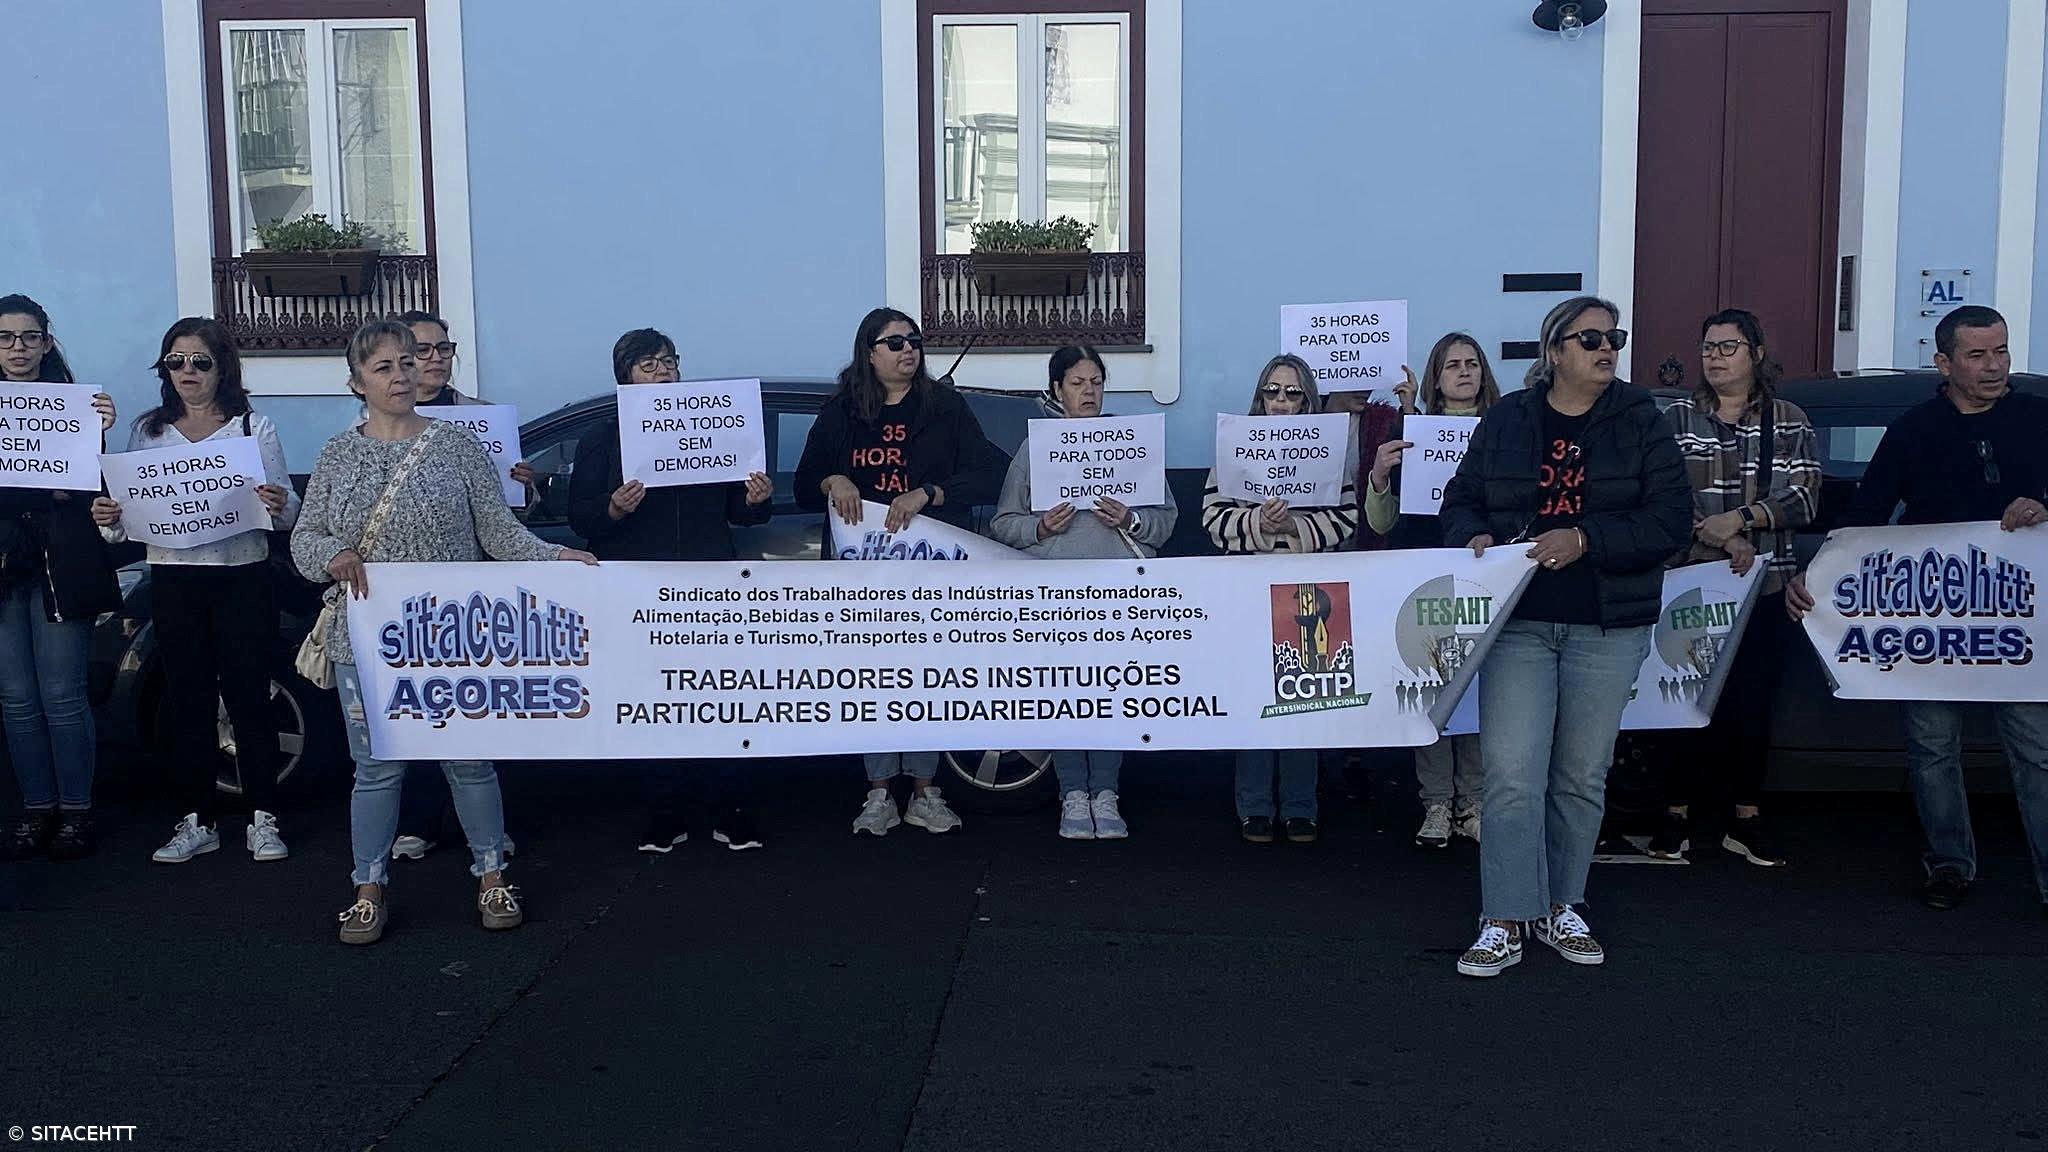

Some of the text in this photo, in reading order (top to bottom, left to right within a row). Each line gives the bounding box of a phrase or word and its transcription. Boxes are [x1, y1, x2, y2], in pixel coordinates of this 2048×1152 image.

[1927, 280, 1963, 301] AL
[1311, 314, 1378, 328] 35 HORAS
[1300, 332, 1389, 346] PARA TODOS
[1331, 350, 1359, 362] SEM
[1311, 366, 1383, 381] DEMORAS!
[0, 396, 65, 411] HORAS
[654, 395, 731, 411] 35 HORAS
[16, 418, 80, 432] TODOS
[642, 415, 744, 432] PARA TODOS
[882, 424, 907, 442] 35
[1061, 429, 1134, 444] 35 HORAS
[1249, 428, 1319, 441] 35 HORAS
[1438, 430, 1454, 442] 35
[2, 438, 40, 451] SEM
[679, 437, 712, 450] SEM
[852, 447, 907, 468] HOR
[1050, 447, 1146, 462] PARA TODOS
[1236, 447, 1328, 460] PARA TODOS
[0, 458, 69, 473] MORAS!
[138, 455, 226, 479] 35 HORAS
[655, 454, 736, 472] DEMORAS!
[874, 468, 909, 492] JÁ!
[1083, 467, 1114, 479] SEM
[1268, 466, 1296, 479] SEM
[1539, 464, 1585, 487] ORA
[128, 475, 244, 499] PARA TODOS
[1059, 481, 1138, 499] DEMORAS!
[1245, 481, 1316, 498] DEMORAS!
[172, 500, 209, 515] SEM
[149, 511, 240, 535] DEMORAS!
[1833, 543, 2036, 617] sitacehtt
[659, 585, 1182, 601] Sindicato dos Trabalhadores das Indústrias Transfomadoras,
[633, 606, 1207, 626] Alimentação,Bebidas e Similares, Comércio,Escriórios e Serviços,
[1416, 596, 1492, 626] FESAHT
[1671, 601, 1738, 631] FESAHT
[379, 586, 590, 667] sitacehtt
[651, 627, 1192, 647] Hotelaria e Turismo,Transportes e Outros Serviços dos Açores
[1835, 624, 2034, 672] AÇORES
[661, 661, 1180, 691] TRABALHADORES DAS INSTITUIÇÕES
[1277, 671, 1353, 700] CGTP
[385, 676, 591, 728] AÇORES
[617, 696, 1227, 724] PARTICULARES DE SOLIDARIEDADE SOCIAL
[1266, 697, 1365, 716] INTERSINDICAL NACIONAL
